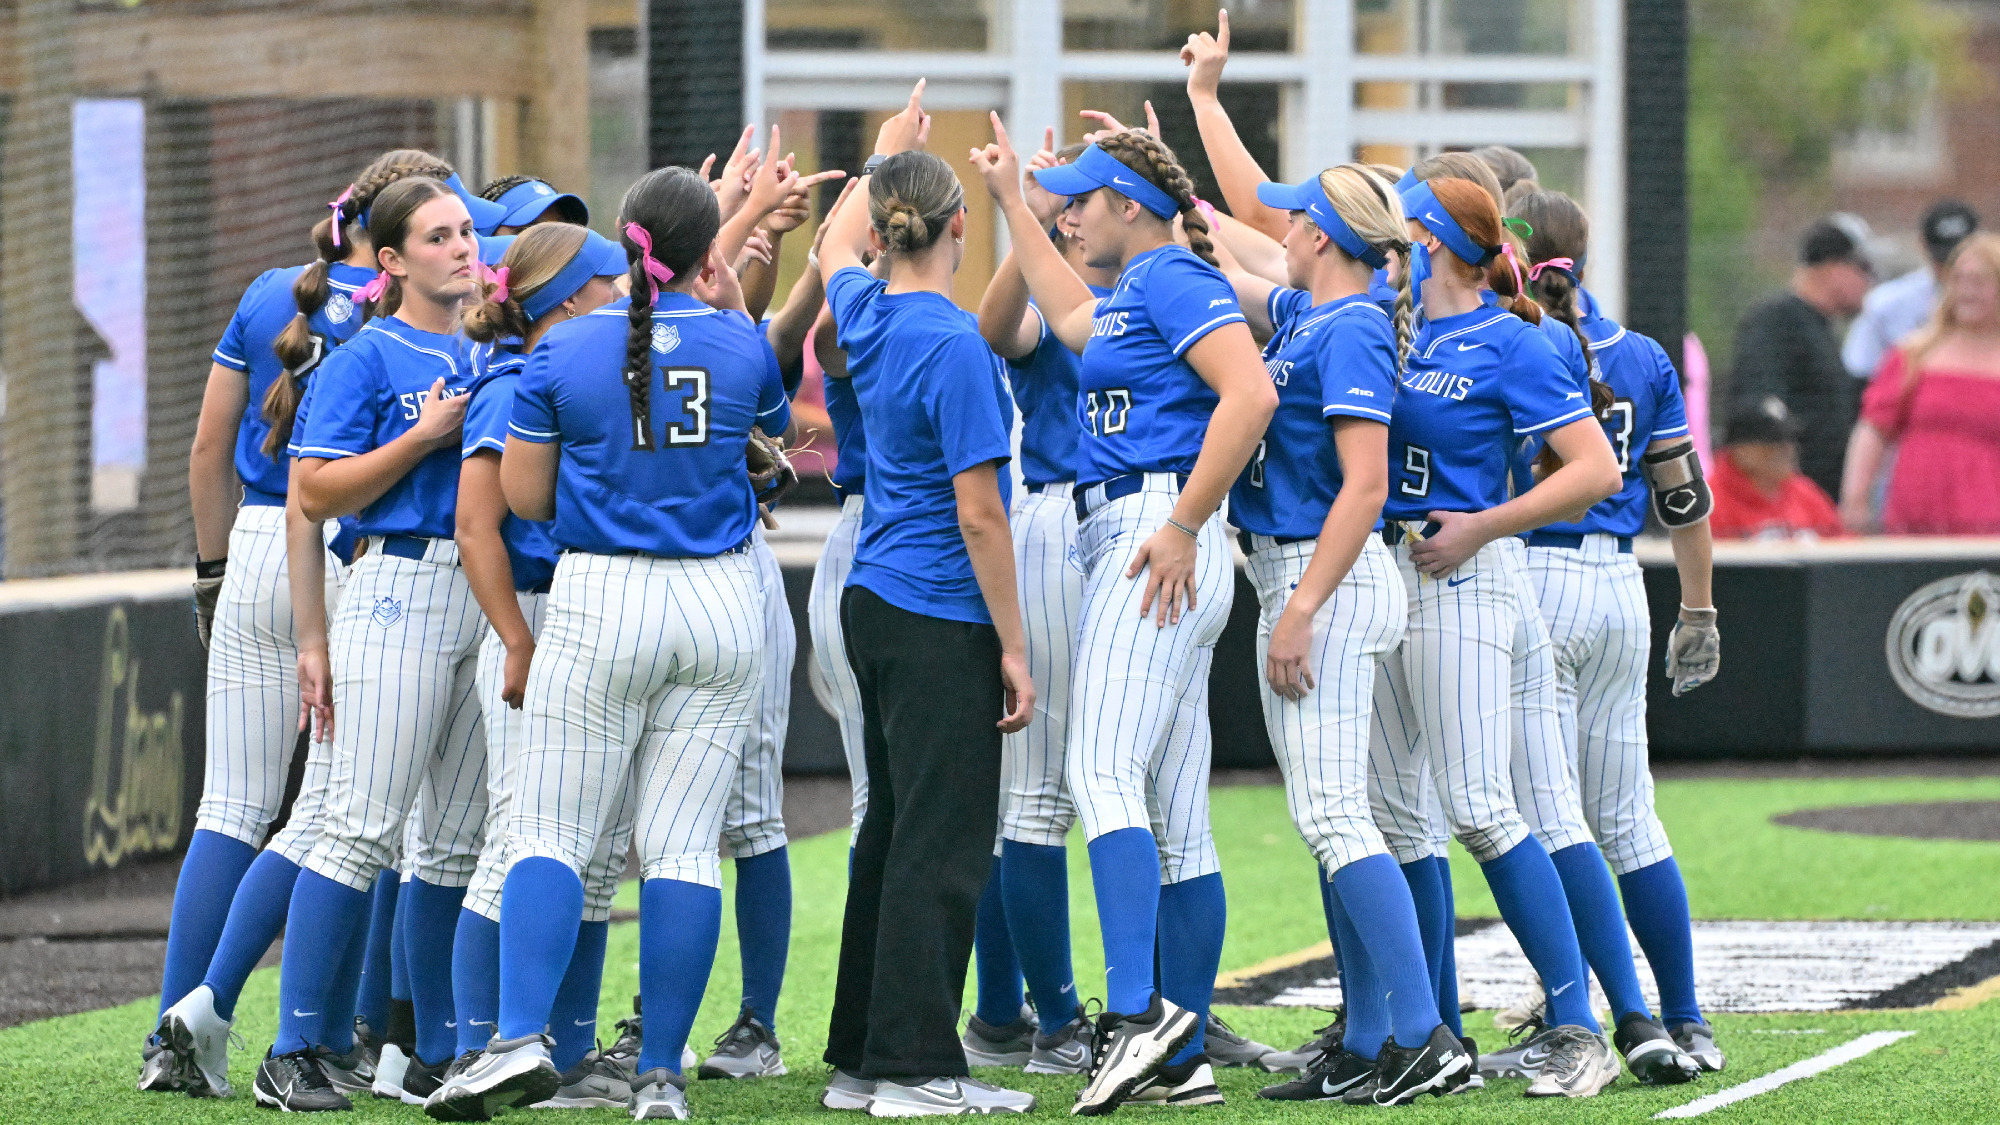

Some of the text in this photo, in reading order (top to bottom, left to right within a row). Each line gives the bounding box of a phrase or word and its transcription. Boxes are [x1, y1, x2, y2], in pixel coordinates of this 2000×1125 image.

[1402, 371, 1474, 401] LOUIS
[1401, 445, 1430, 496] 9
[1919, 618, 2000, 680] OV
